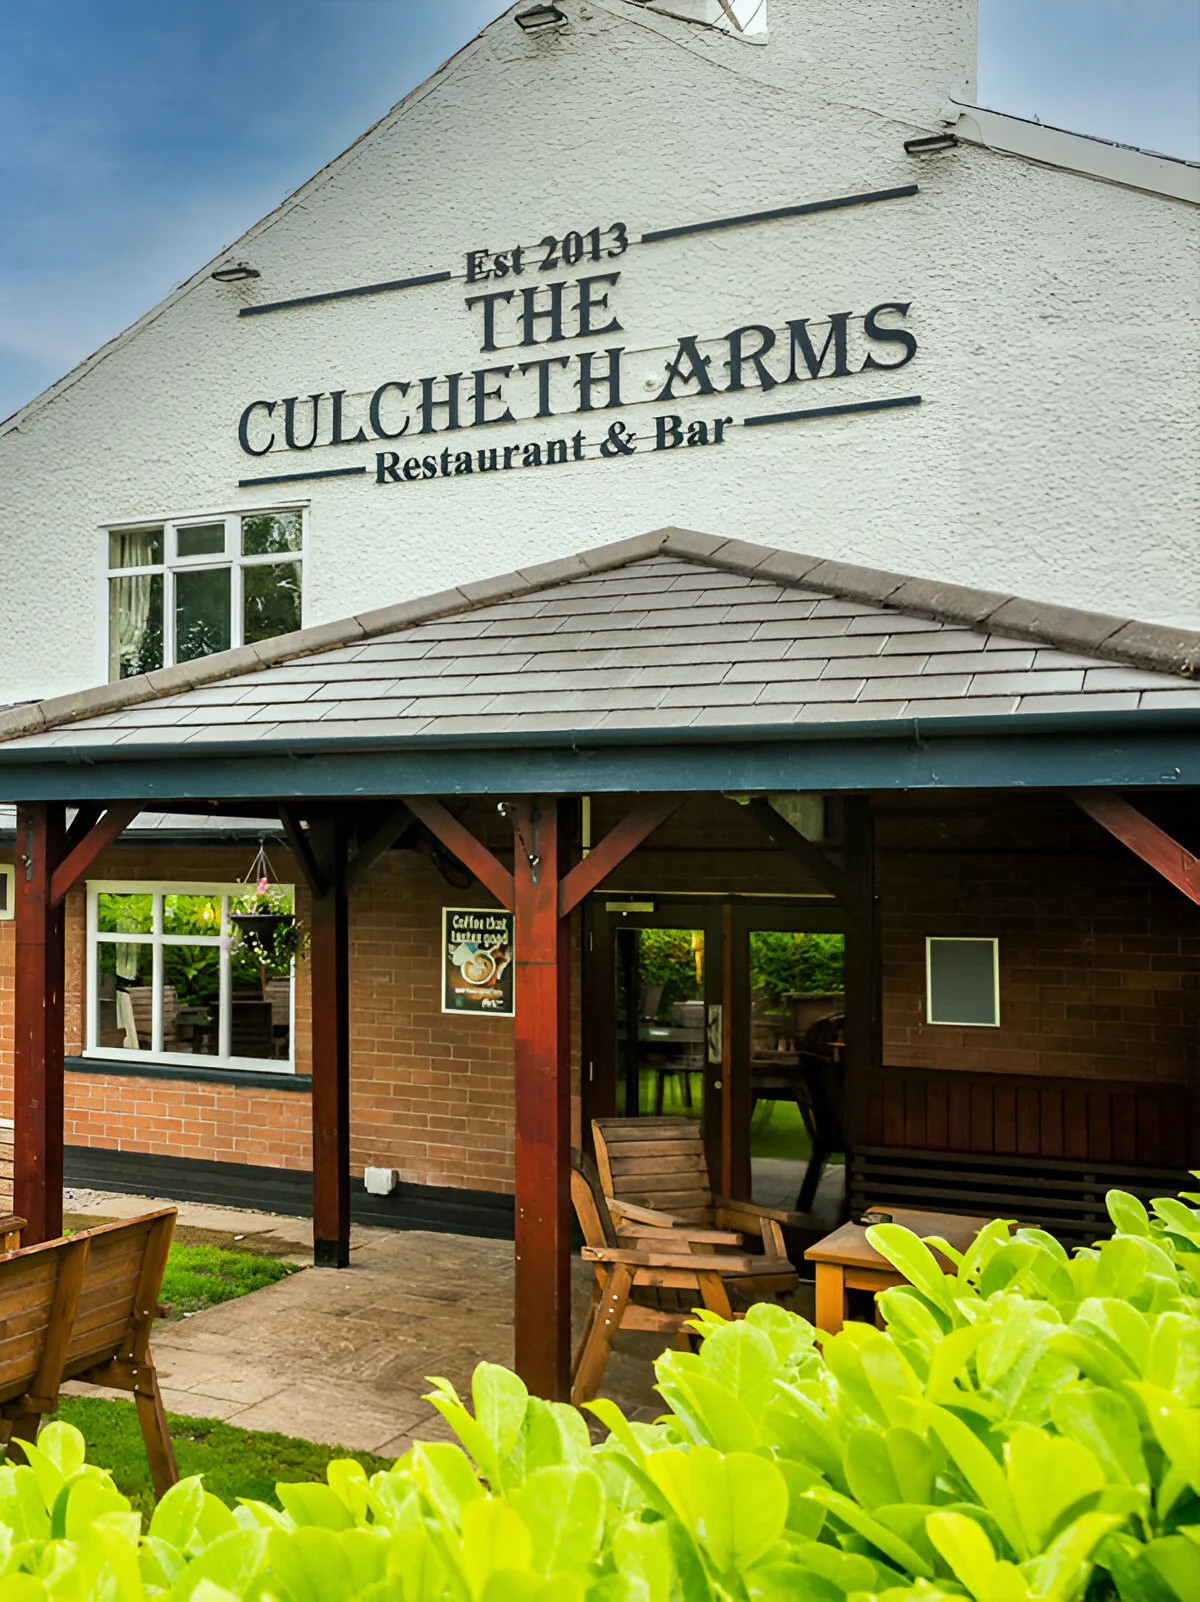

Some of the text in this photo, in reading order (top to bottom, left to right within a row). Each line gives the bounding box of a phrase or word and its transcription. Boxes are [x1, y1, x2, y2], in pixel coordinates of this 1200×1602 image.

[465, 222, 629, 284] Est 2013
[464, 271, 622, 353] THE
[238, 302, 920, 458] CULCHETH ARMS
[375, 414, 734, 484] Restaurant & Bar
